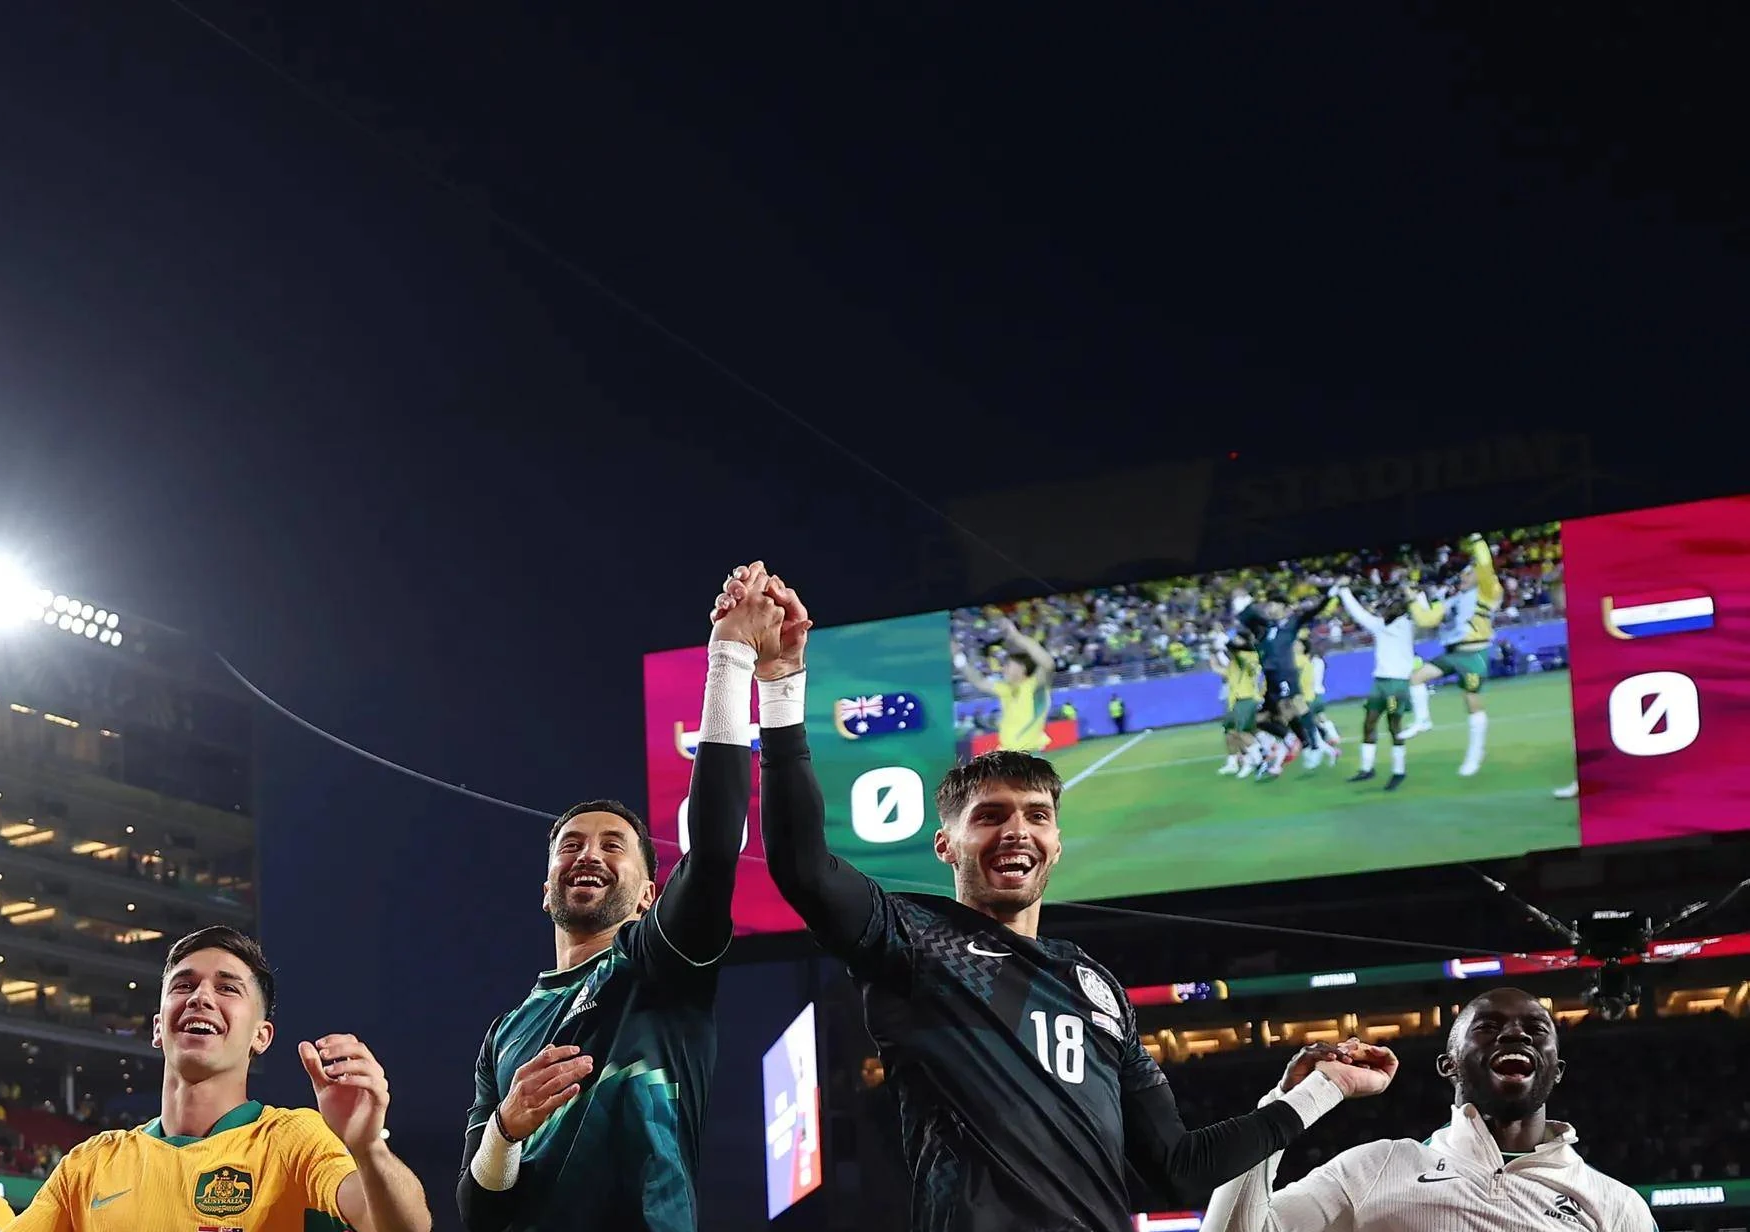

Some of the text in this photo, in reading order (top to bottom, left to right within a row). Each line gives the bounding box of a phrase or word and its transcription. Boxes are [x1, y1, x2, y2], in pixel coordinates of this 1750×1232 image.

[1609, 671, 1700, 756] 0
[851, 766, 925, 843] 0
[1029, 1010, 1085, 1084] 18
[1436, 1159, 1445, 1171] 6
[1651, 1186, 1725, 1206] AUSTRALIA
